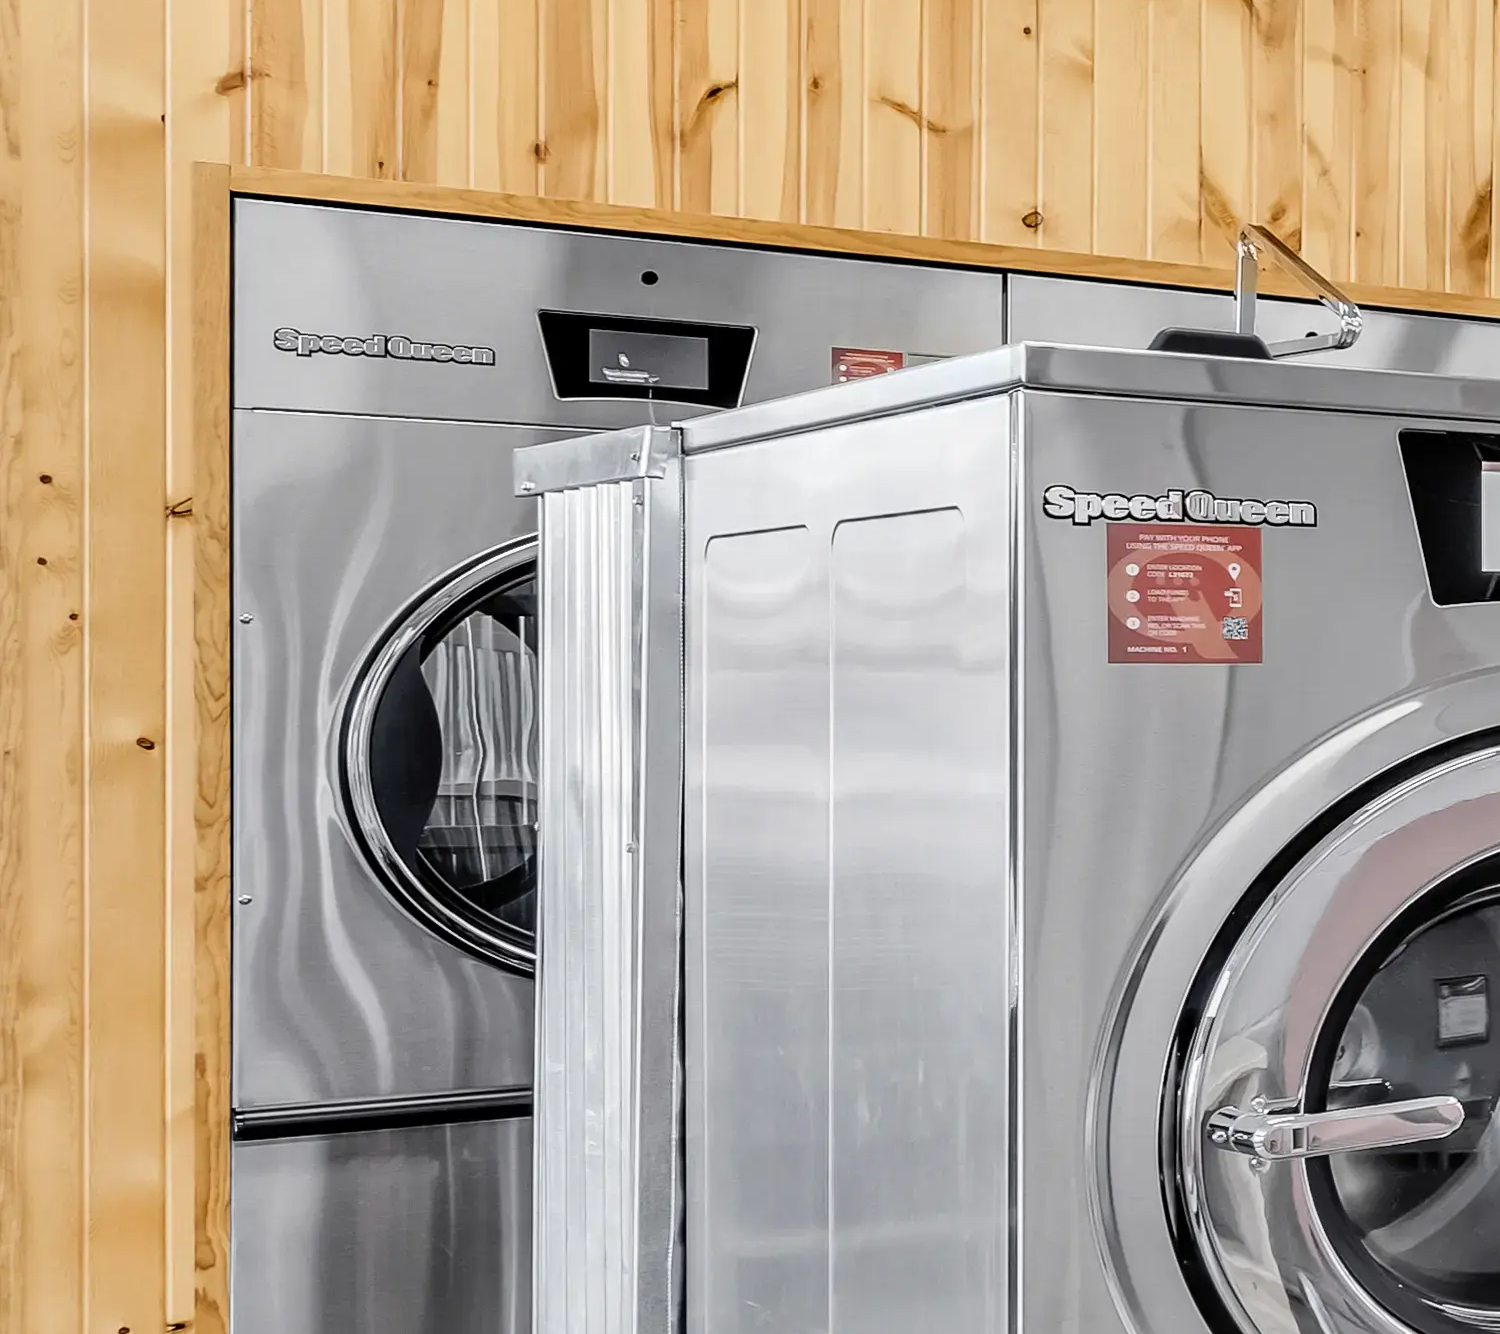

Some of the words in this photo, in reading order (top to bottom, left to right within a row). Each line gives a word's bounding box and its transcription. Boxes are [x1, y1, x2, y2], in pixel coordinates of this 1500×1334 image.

[274, 327, 387, 358] Speed
[387, 336, 496, 366] Queen
[1043, 484, 1185, 526] Speed
[1184, 489, 1317, 527] Queen
